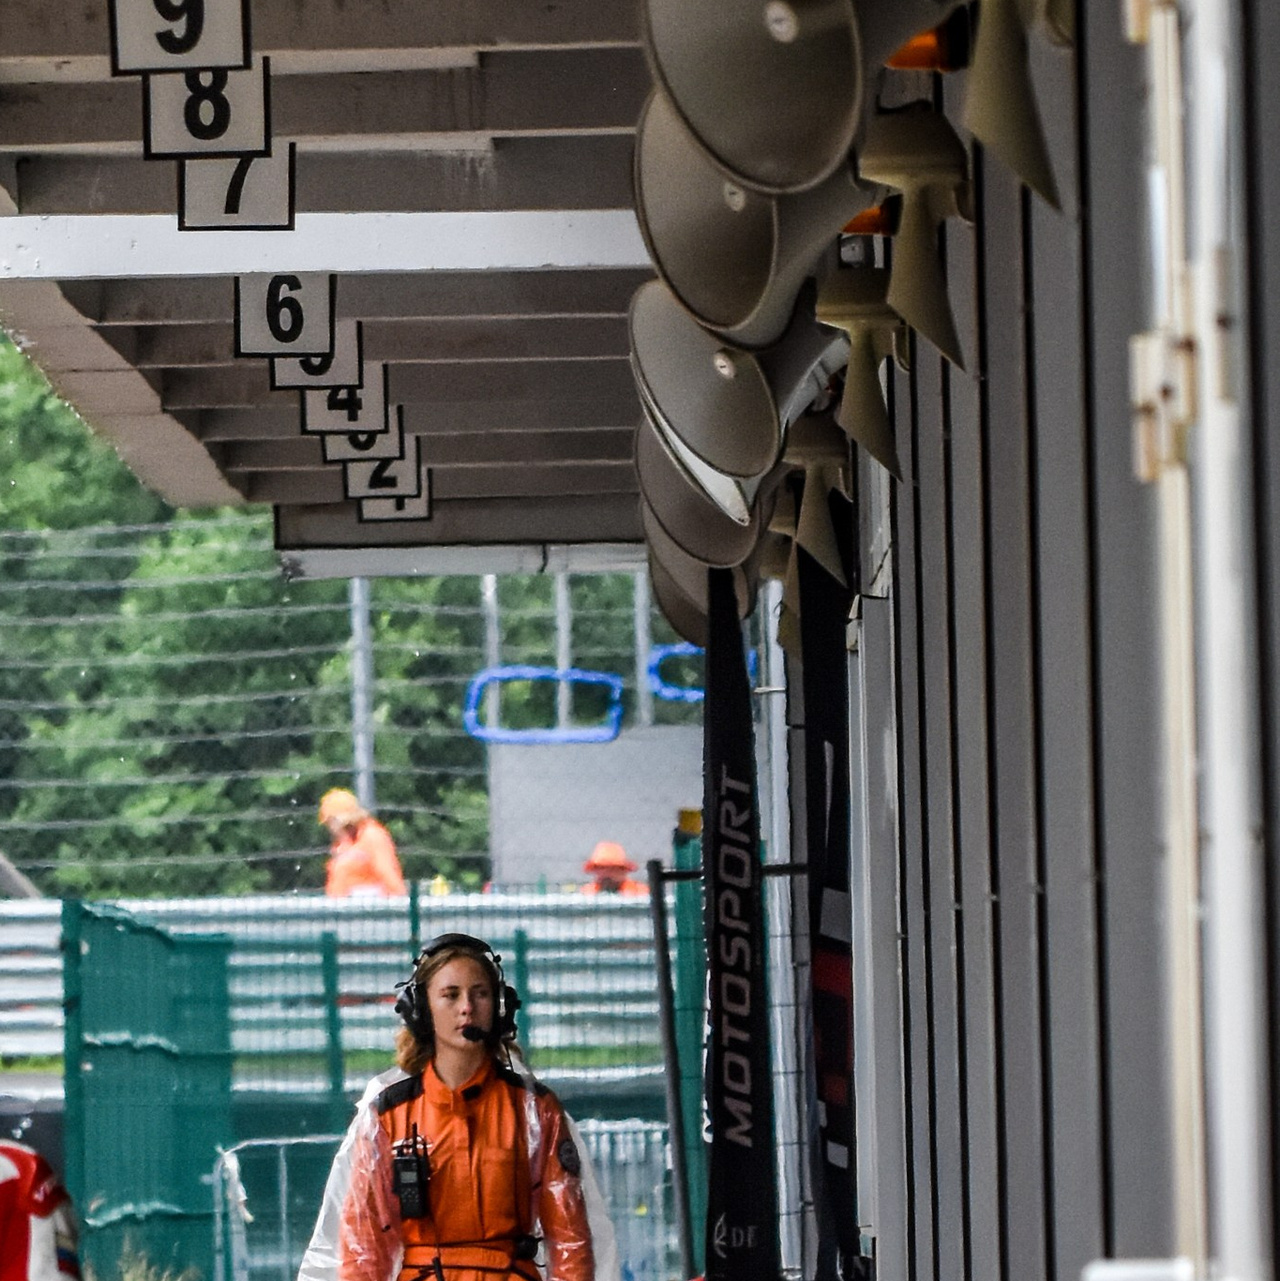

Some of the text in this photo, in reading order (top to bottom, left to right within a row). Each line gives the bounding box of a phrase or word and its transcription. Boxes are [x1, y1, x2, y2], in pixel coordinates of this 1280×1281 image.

[183, 70, 231, 141] 8
[266, 275, 304, 343] 6
[718, 763, 754, 1148] MOTOSPORT
